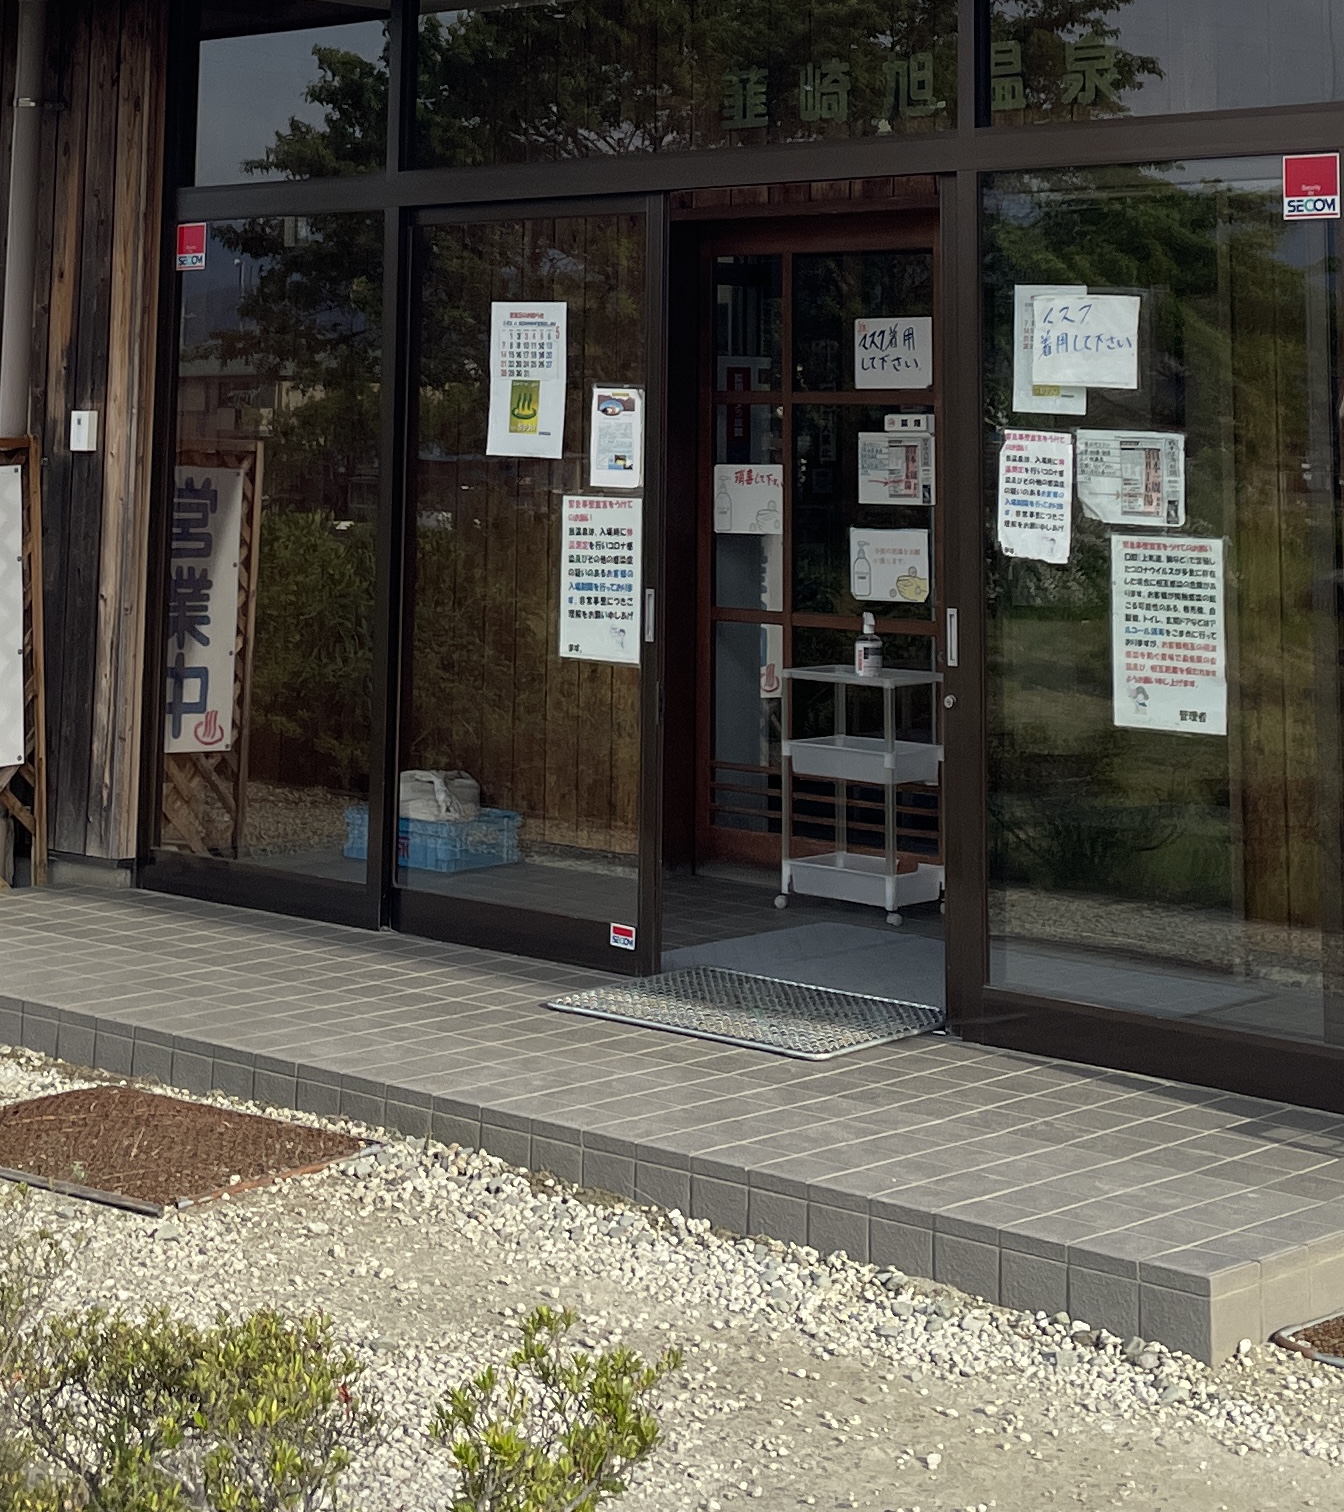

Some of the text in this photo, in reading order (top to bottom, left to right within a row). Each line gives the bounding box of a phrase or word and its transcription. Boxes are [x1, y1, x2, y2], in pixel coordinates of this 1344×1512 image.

[1287, 198, 1336, 213] SECOM
[178, 255, 203, 266] SECOM
[1179, 709, 1207, 723] 管理者
[612, 935, 634, 947] SECOM
